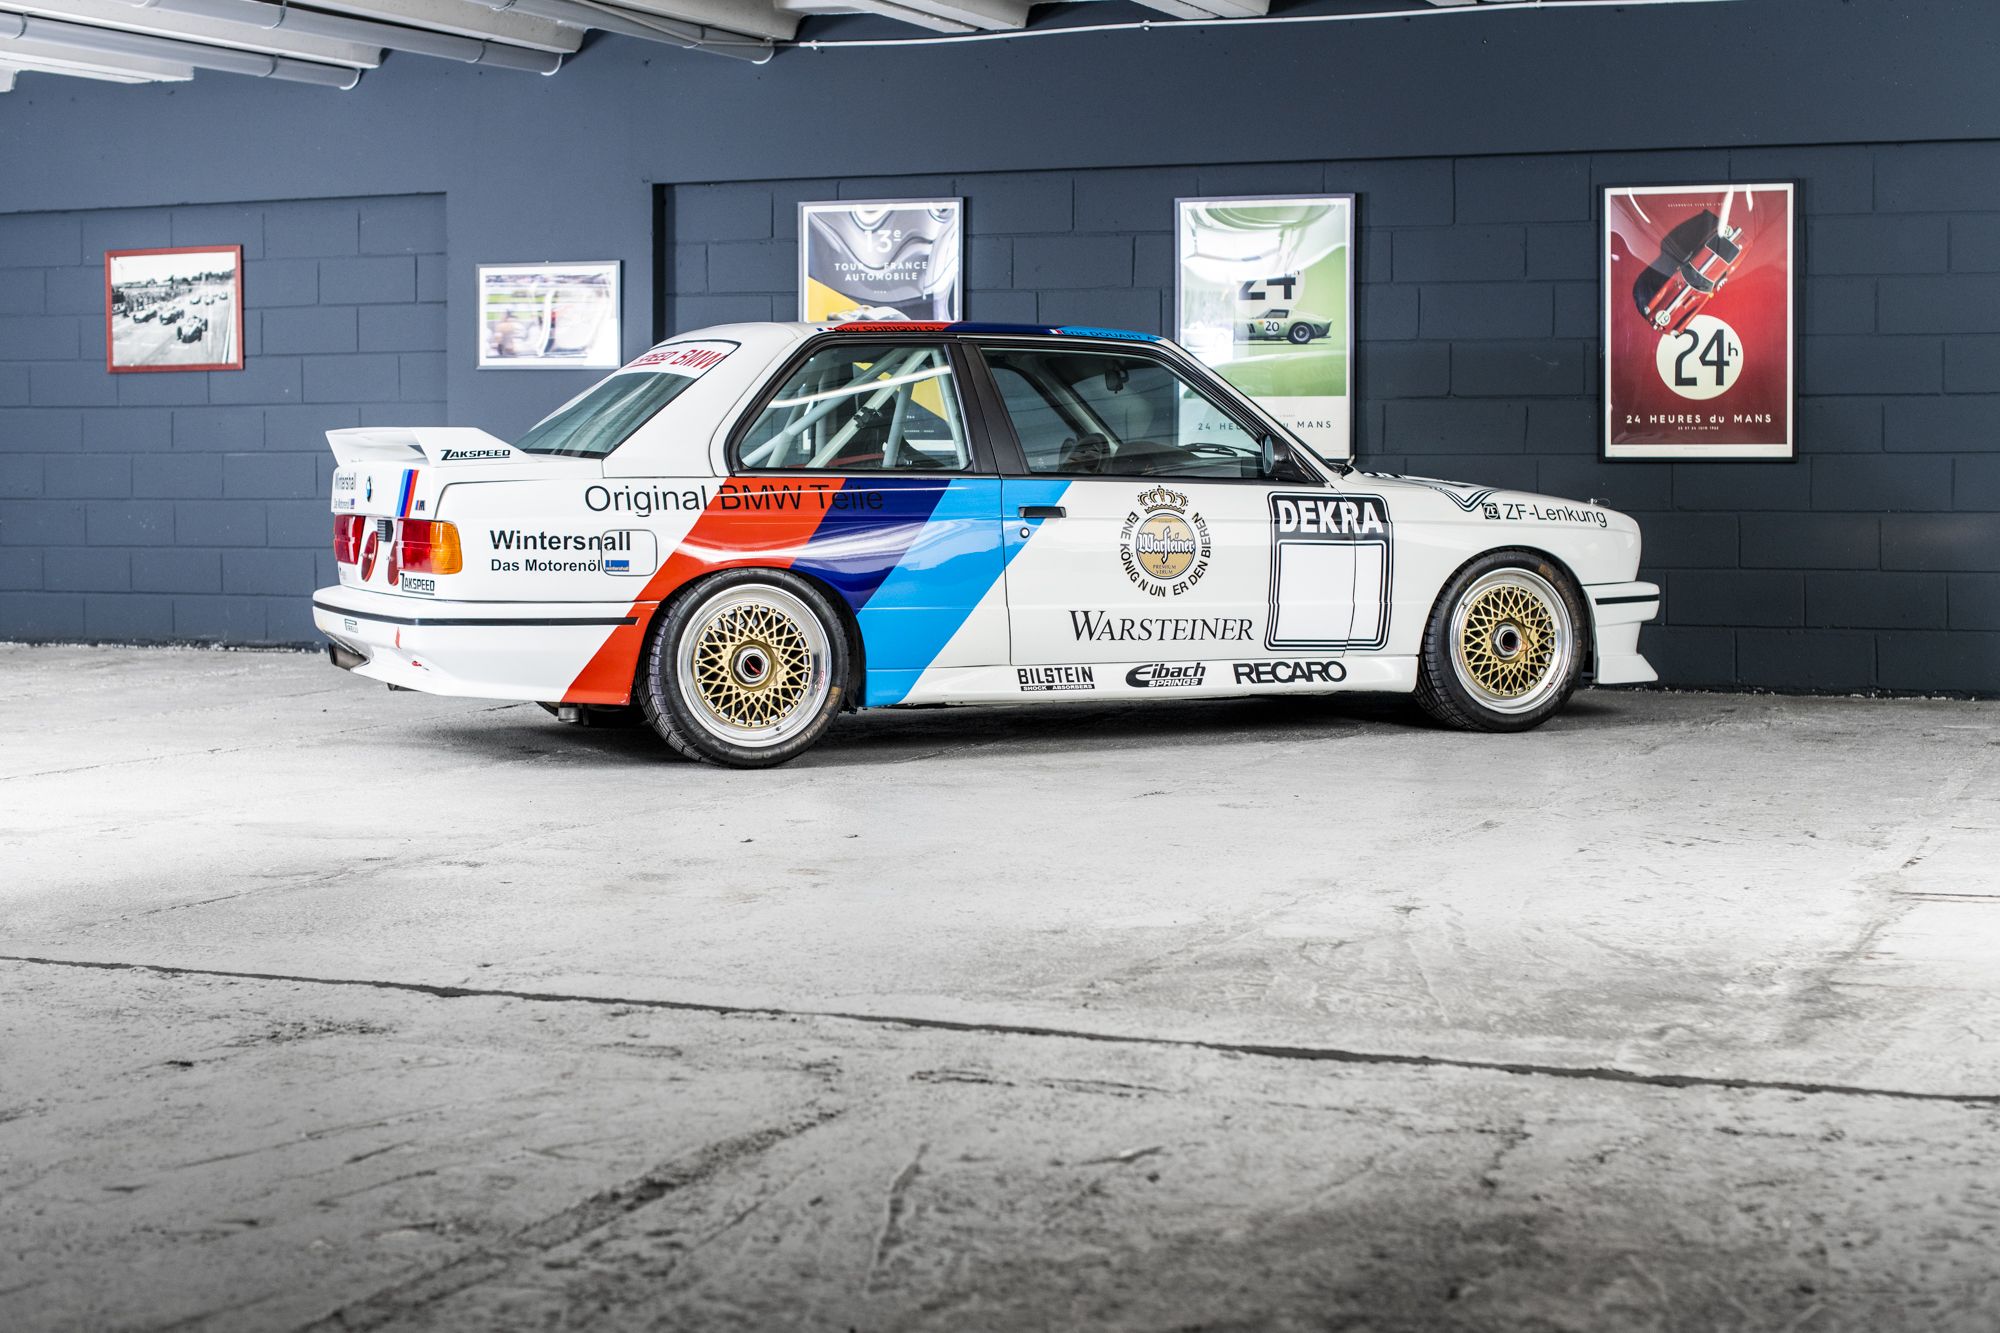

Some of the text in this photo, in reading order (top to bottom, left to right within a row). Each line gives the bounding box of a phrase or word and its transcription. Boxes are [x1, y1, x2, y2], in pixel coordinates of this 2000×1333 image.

[834, 262, 864, 272] TOUR
[883, 261, 928, 270] FRANCE
[845, 272, 918, 281] AUTOMOBILE
[1264, 321, 1280, 332] 20
[670, 349, 728, 370] BMW
[1198, 423, 1211, 431] 24
[1219, 422, 1242, 430] HEU
[1297, 420, 1332, 429] MANS
[1626, 414, 1772, 424] 24 HEURES du MANS
[440, 449, 511, 461] ZAKSPEED
[584, 484, 884, 518] Original BMW Teile
[1277, 499, 1385, 534] DEKRA
[1502, 503, 1608, 528] ZF-Lenkung
[1191, 512, 1211, 558] BIEREN
[491, 559, 601, 572] Das Motorenöl
[1187, 560, 1209, 586] DEN
[400, 573, 435, 596] ZAKSPEED
[1068, 609, 1255, 641] WARSTEINER
[1016, 666, 1094, 685] BILSTEIN
[1125, 662, 1207, 688] Eibach
[1147, 678, 1199, 687] SPRINGS
[1232, 661, 1348, 685] RECARO
